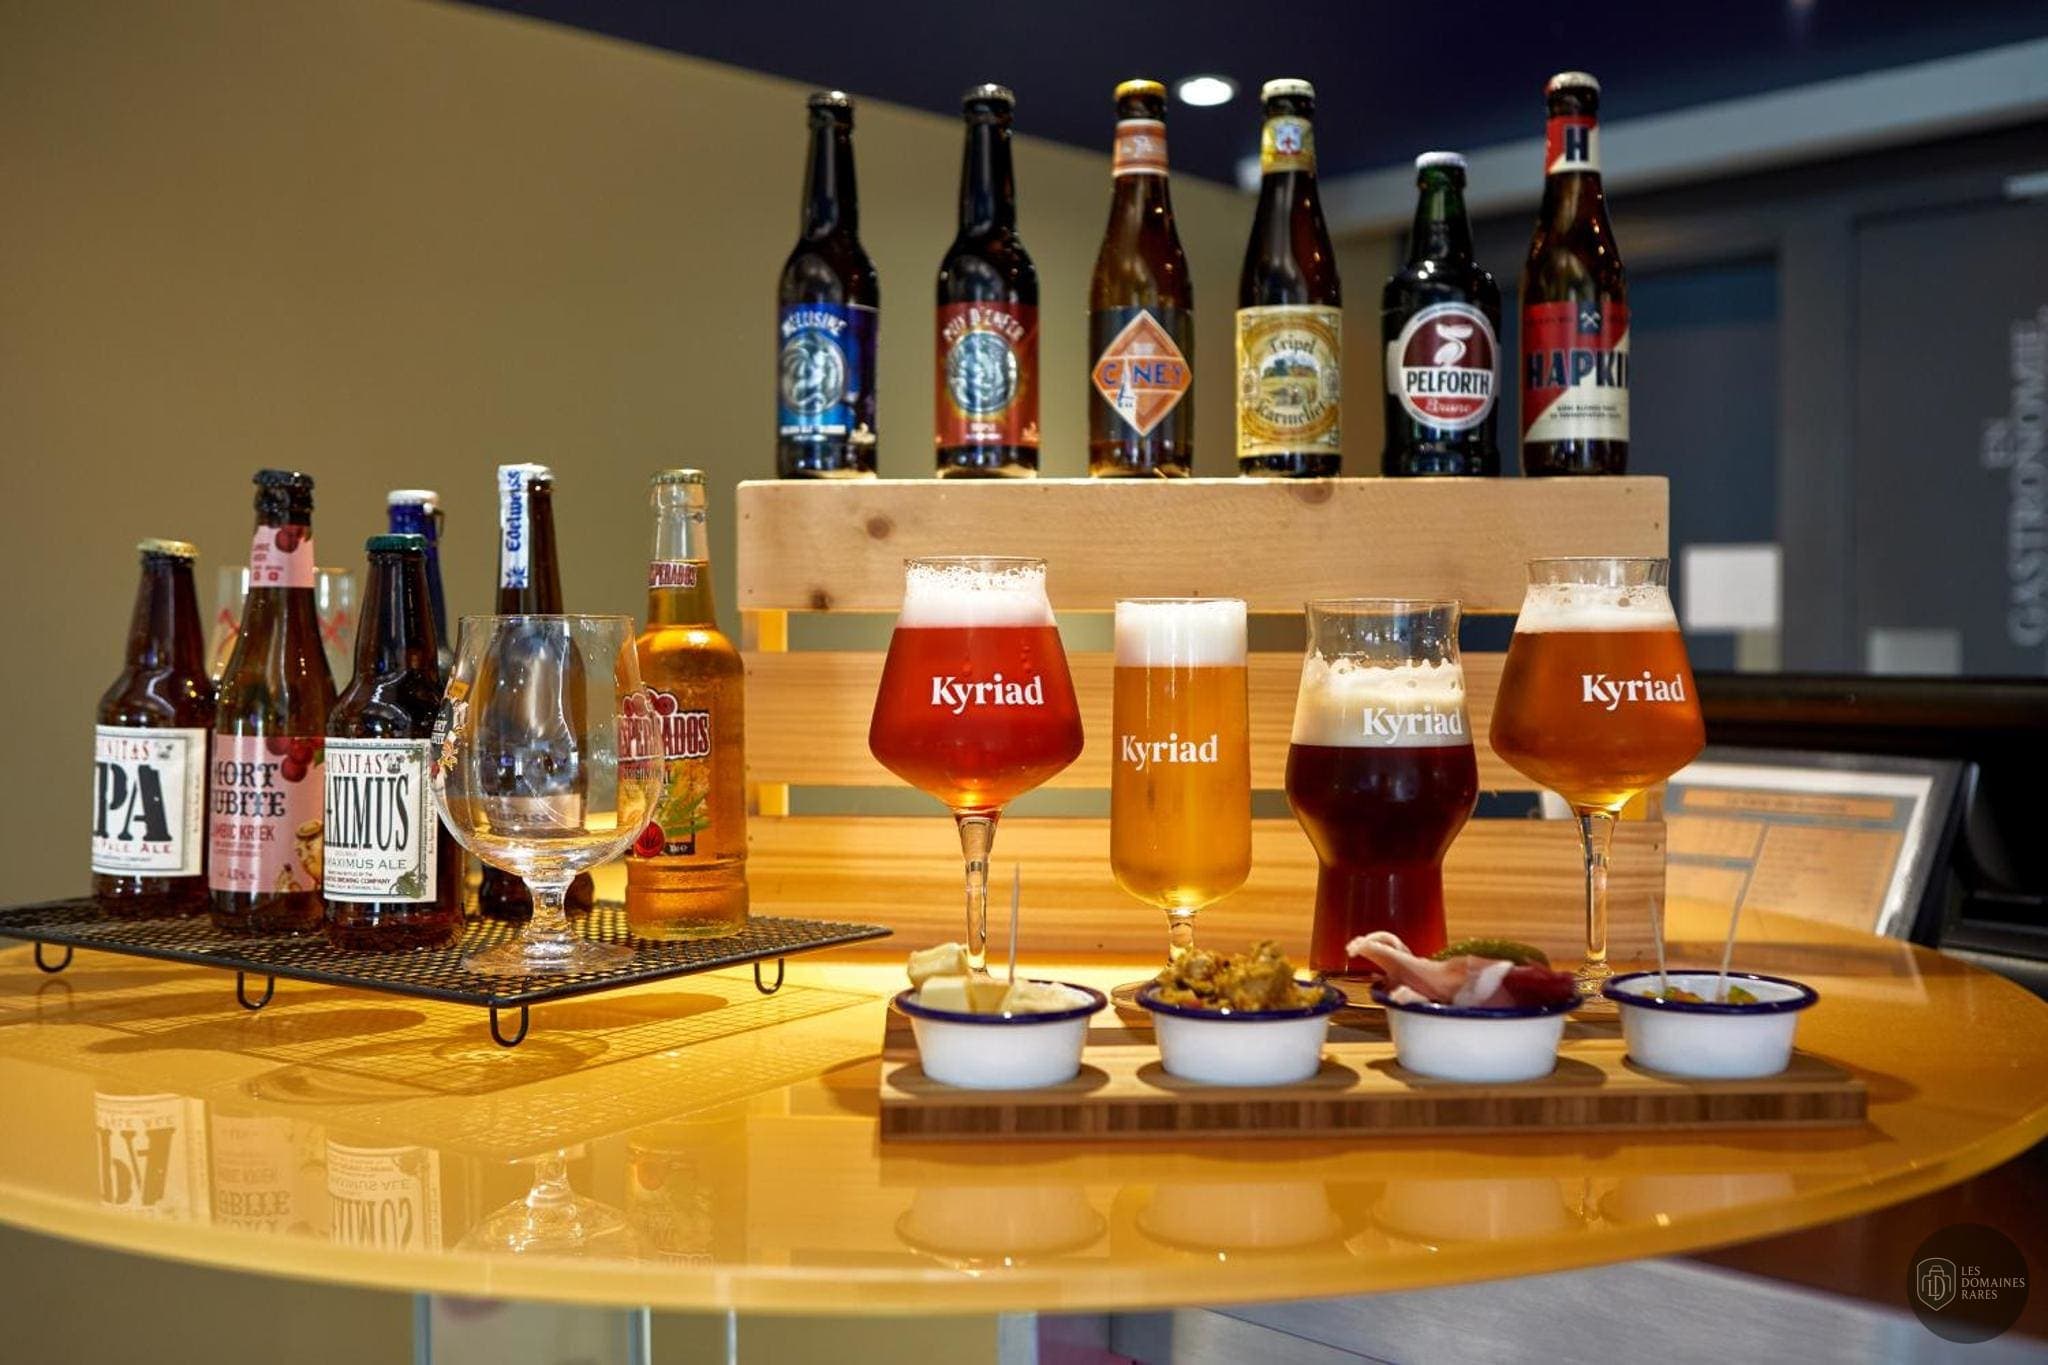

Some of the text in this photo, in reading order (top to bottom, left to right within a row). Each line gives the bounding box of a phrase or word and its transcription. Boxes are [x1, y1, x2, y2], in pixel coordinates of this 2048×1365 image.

[1565, 126, 1589, 161] H
[1406, 370, 1490, 395] PELFORTH
[1527, 350, 1628, 389] HAPKI
[931, 673, 1044, 715] Kyriad
[1582, 671, 1687, 711] Kyriad
[1362, 706, 1464, 745] Kyriad
[1121, 733, 1218, 771] Kyriad
[240, 824, 276, 842] KREK
[377, 858, 407, 870] ALE
